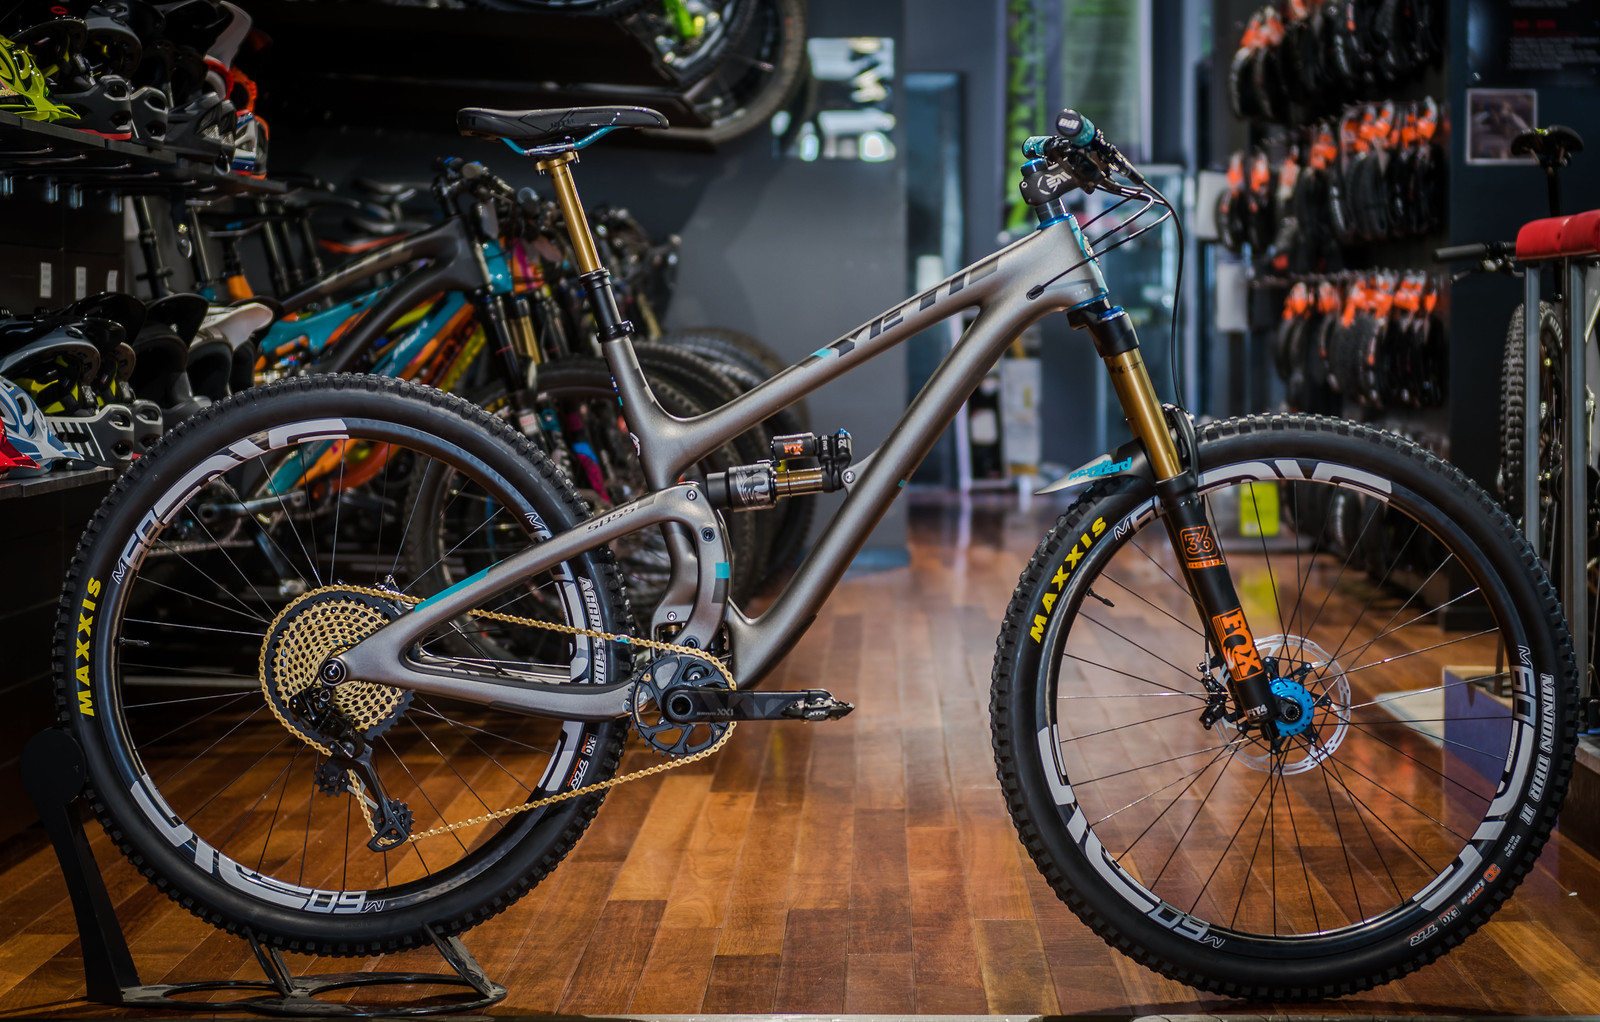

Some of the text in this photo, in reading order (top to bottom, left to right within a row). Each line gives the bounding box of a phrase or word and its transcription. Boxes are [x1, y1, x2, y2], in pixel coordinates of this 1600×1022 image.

[1184, 526, 1215, 553] 36
[1030, 517, 1107, 644] MAXXIS
[75, 577, 101, 718] MAXXIS
[1221, 608, 1264, 680] FOX
[1511, 645, 1537, 728] M60
[1540, 673, 1556, 754] MINION
[584, 735, 598, 756] EXO
[571, 759, 589, 791] TR
[1528, 754, 1550, 802] DHR
[304, 888, 386, 914] M60
[1147, 901, 1226, 949] M60
[1441, 908, 1459, 923] EXO
[1410, 923, 1438, 946] TR
